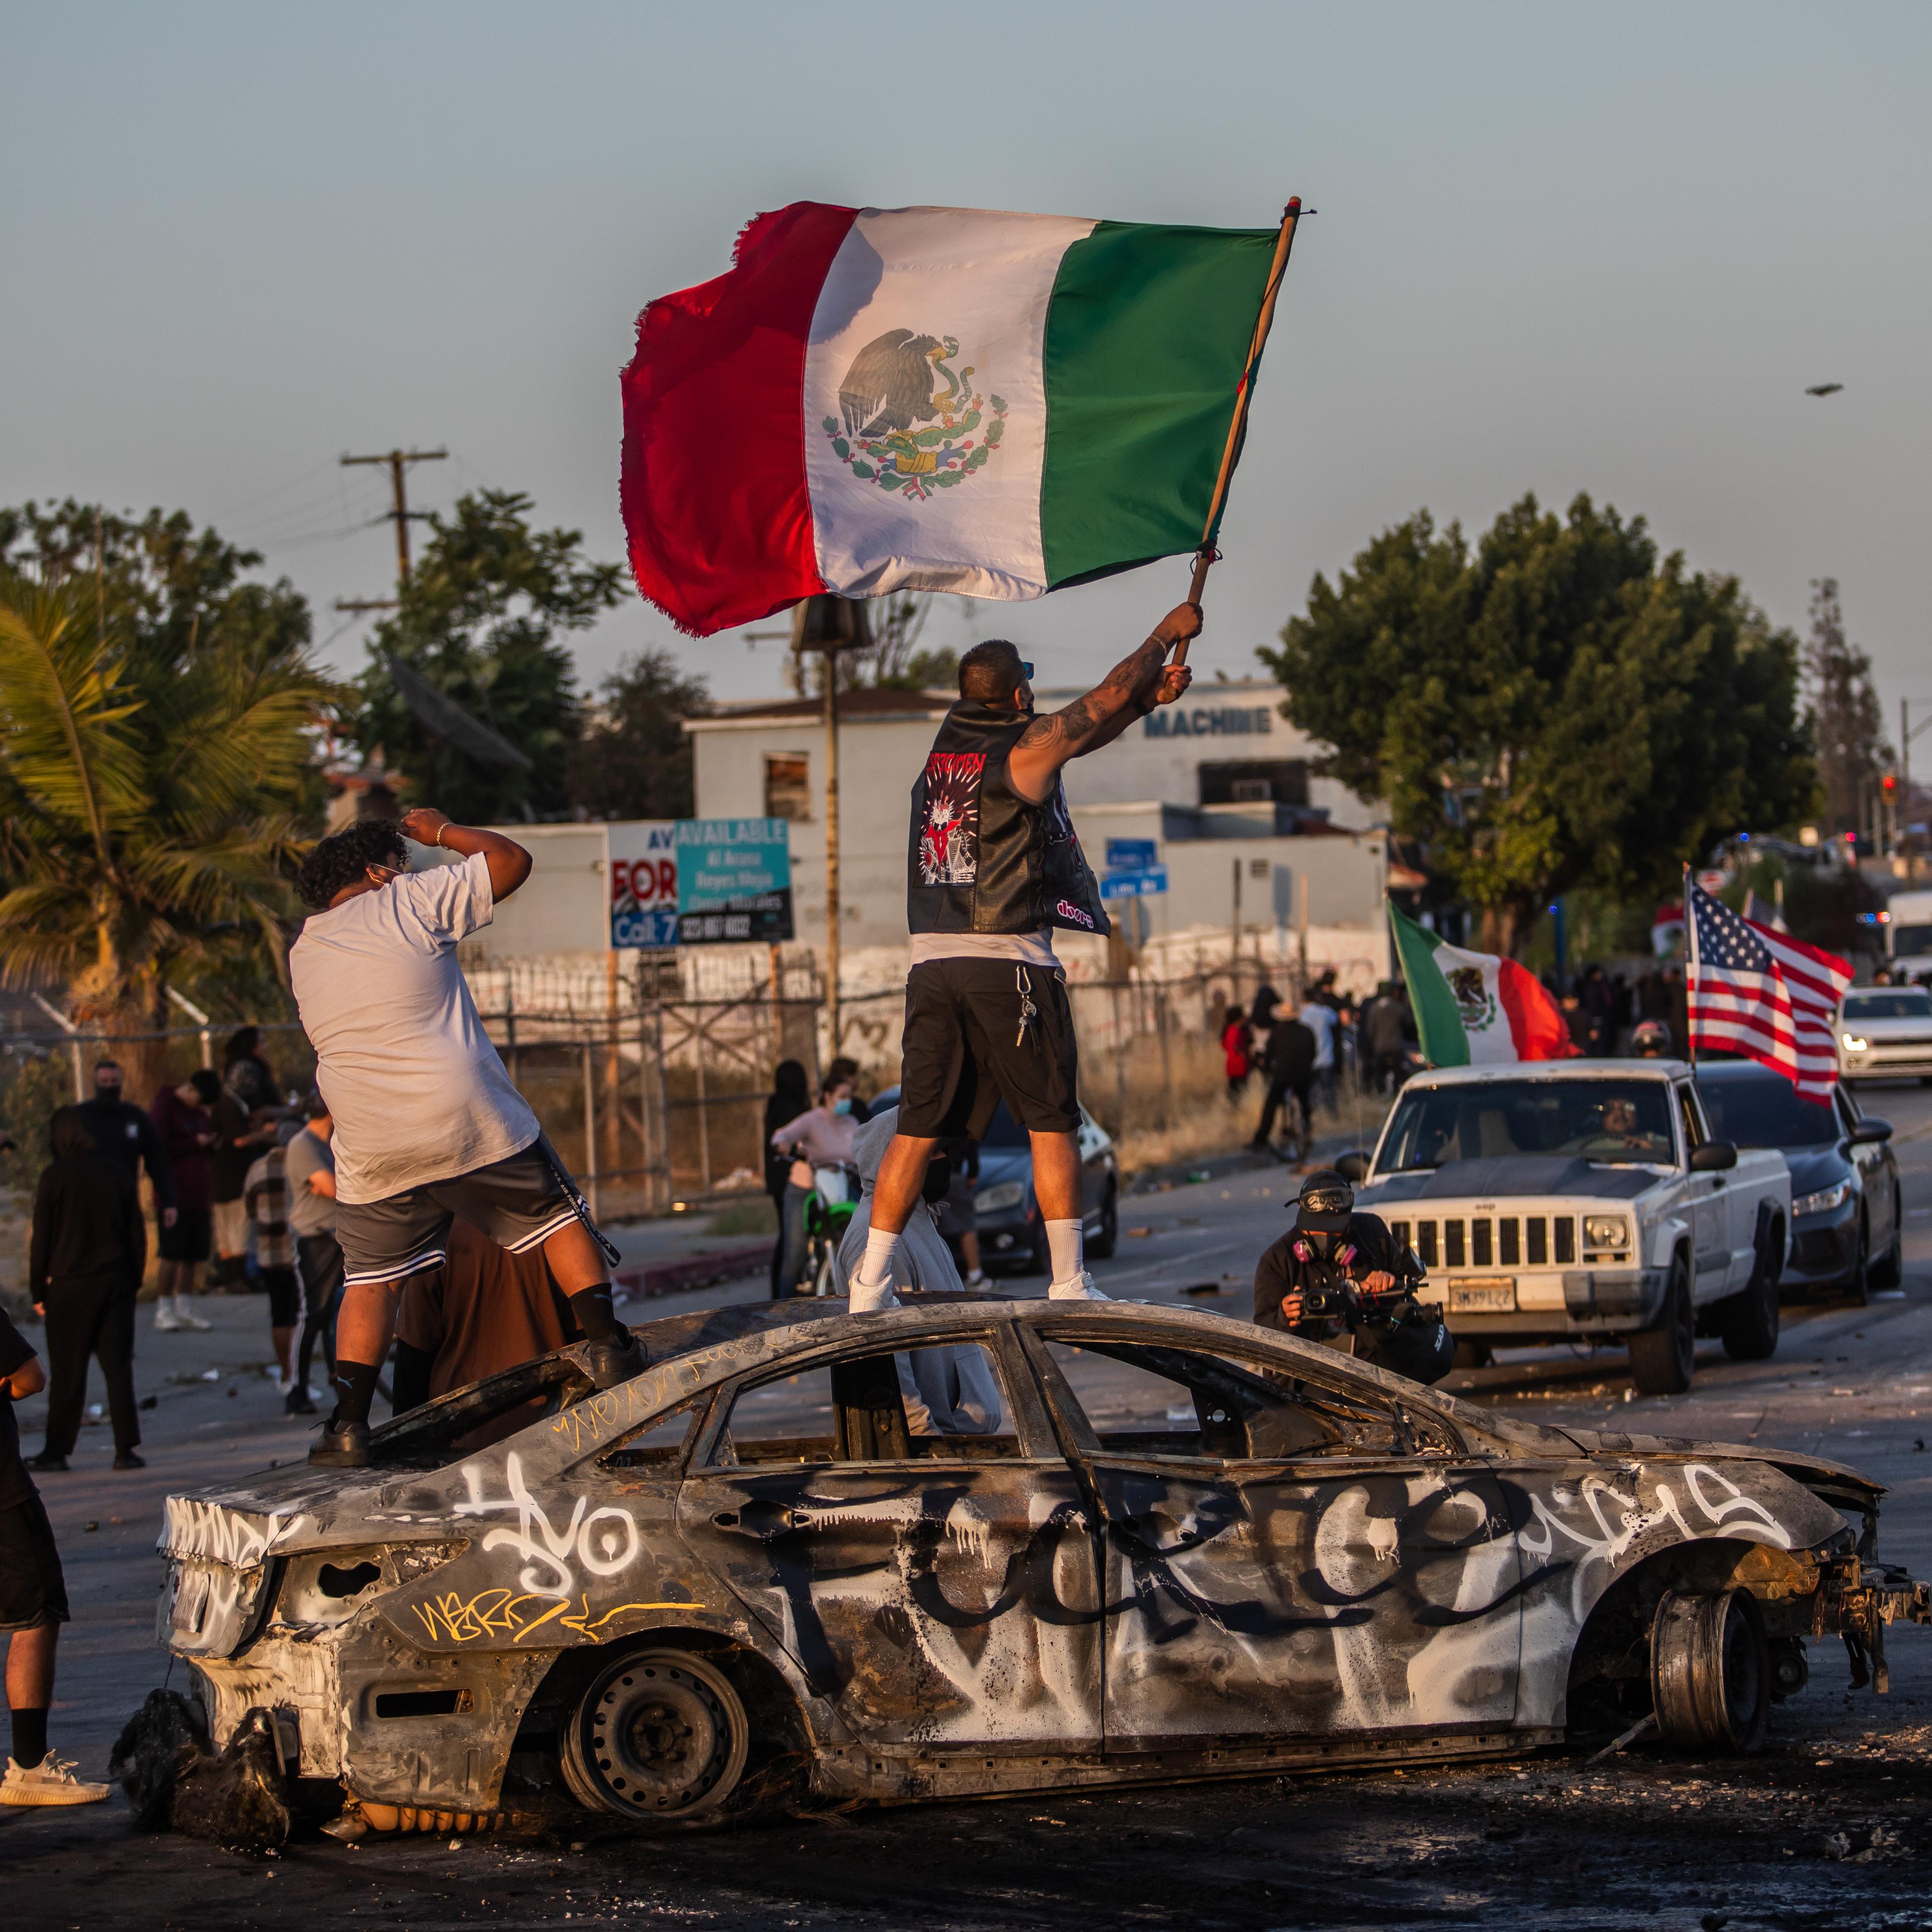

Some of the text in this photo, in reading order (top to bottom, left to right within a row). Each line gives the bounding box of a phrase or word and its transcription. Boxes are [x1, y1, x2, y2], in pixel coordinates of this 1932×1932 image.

[1144, 706, 1271, 738] MACHINE
[926, 753, 987, 775] SPECIMEN
[678, 820, 786, 844] AVAILABLE
[612, 858, 677, 901] FOR
[1057, 900, 1094, 929] doors
[560, 1184, 569, 1194] AIR
[567, 1194, 581, 1213] FORCE
